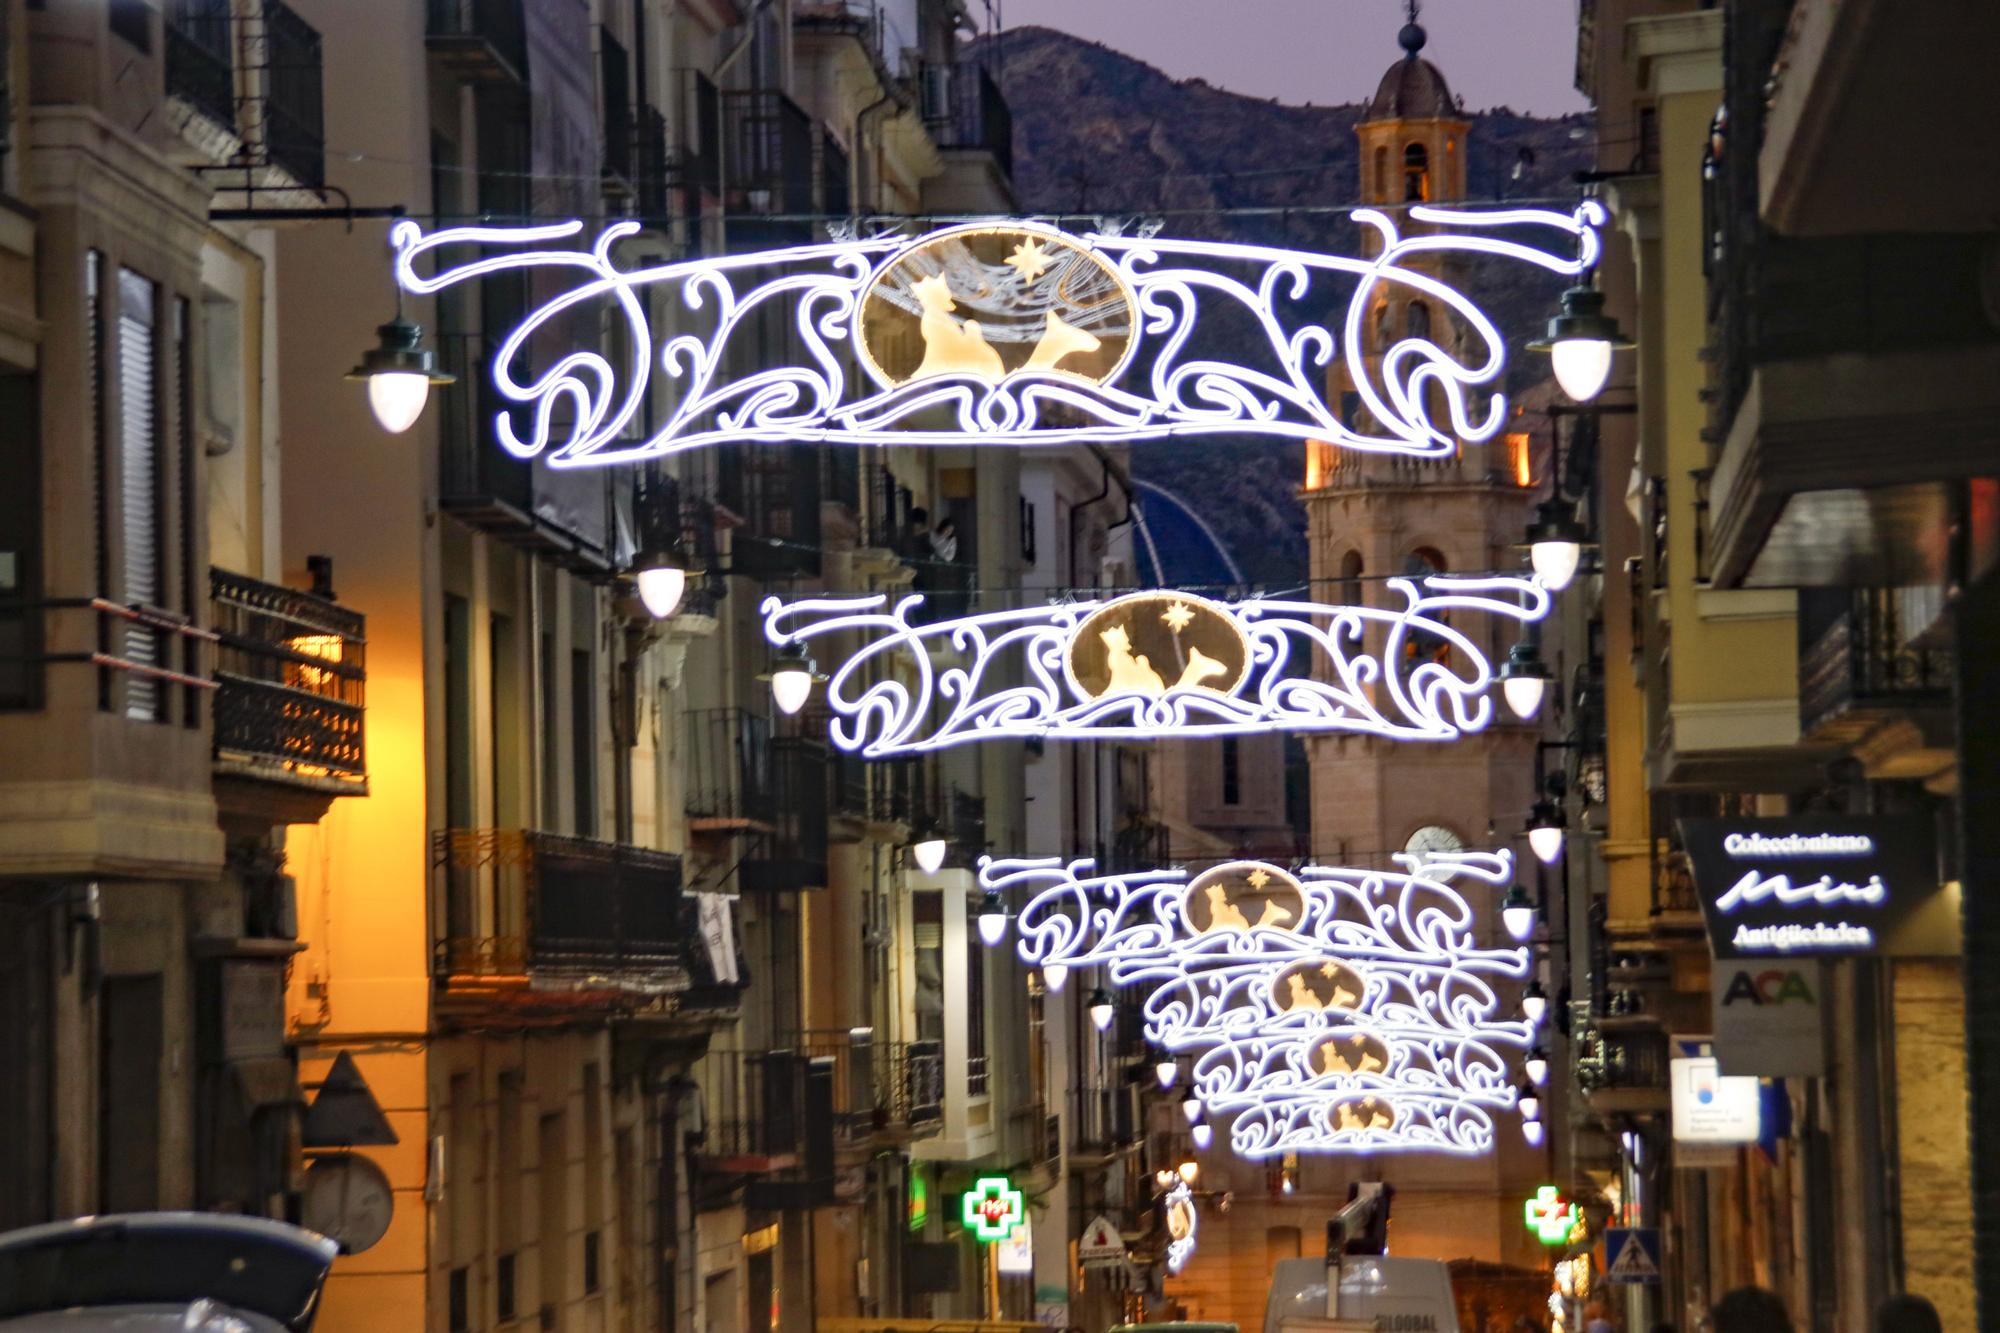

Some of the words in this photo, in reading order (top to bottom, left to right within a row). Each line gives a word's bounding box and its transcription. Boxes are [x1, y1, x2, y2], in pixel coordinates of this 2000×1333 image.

[1725, 833, 1870, 856] Coleccionismo
[1732, 922, 1871, 950] Antigüedades
[1723, 971, 1816, 1006] ACA
